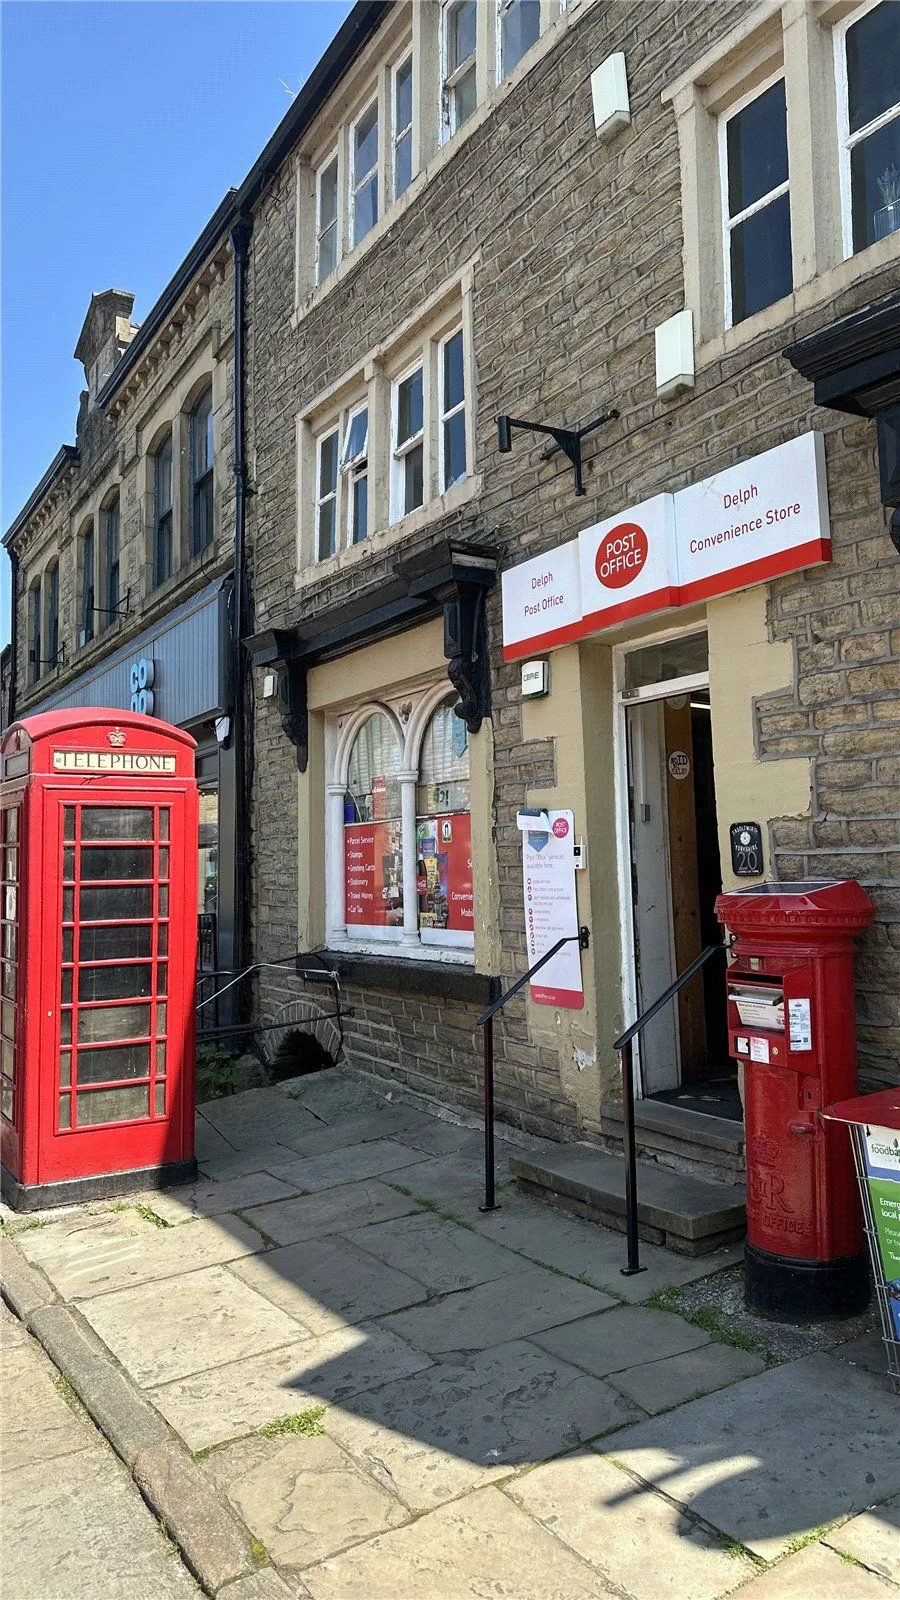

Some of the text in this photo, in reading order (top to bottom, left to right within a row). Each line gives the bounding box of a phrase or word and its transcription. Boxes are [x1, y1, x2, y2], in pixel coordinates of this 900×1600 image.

[723, 484, 758, 509] Delph
[690, 503, 800, 553] Convenience Store
[606, 532, 637, 559] POST
[600, 548, 642, 578] OFFICE
[531, 571, 553, 589] Delph
[524, 595, 564, 616] Post Office
[61, 752, 171, 770] TELEPHONE
[737, 851, 757, 871] 20
[881, 1208, 898, 1219] local
